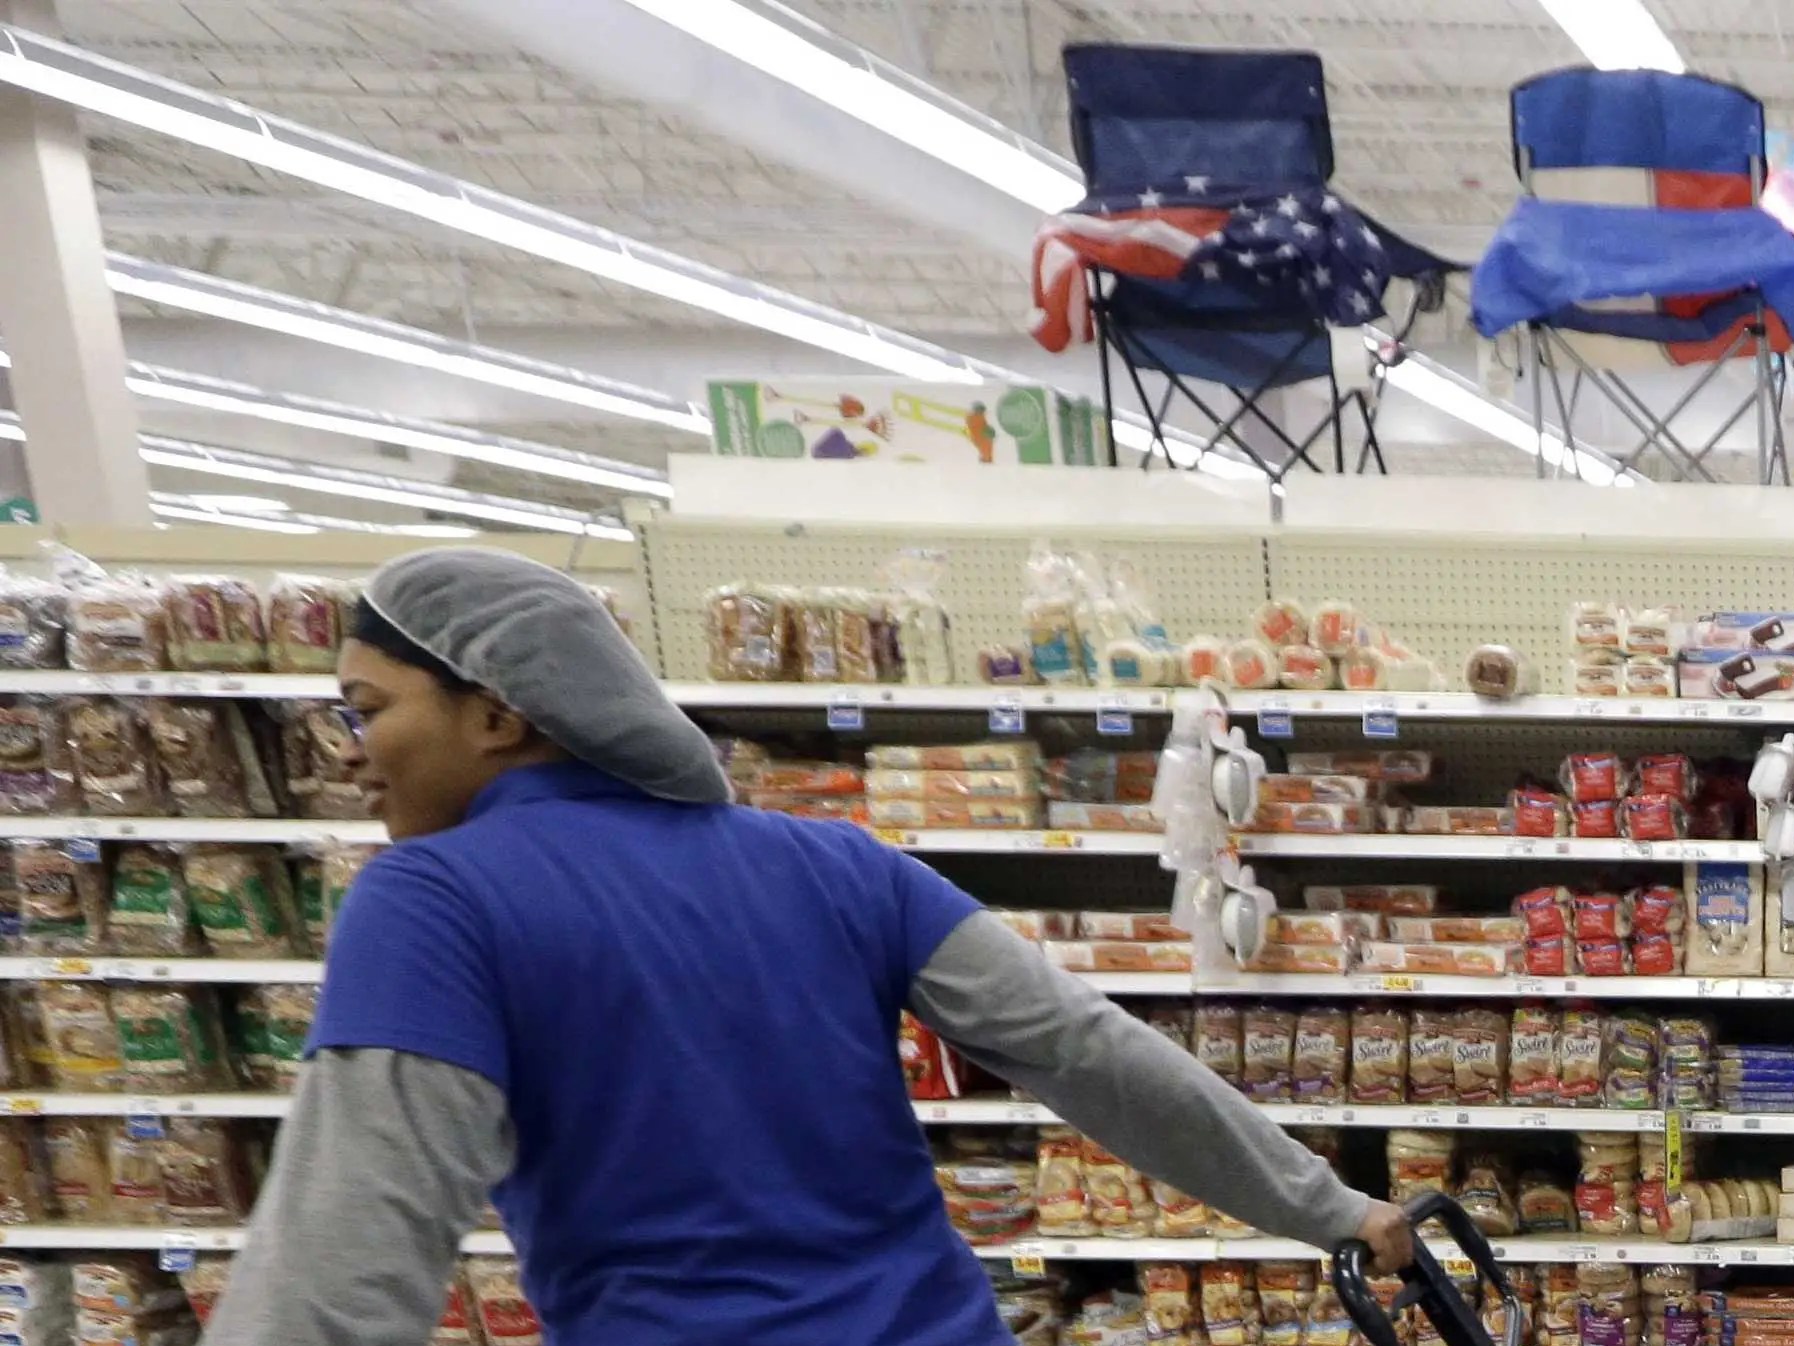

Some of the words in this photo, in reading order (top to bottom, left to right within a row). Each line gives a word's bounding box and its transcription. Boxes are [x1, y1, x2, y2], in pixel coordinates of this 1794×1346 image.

[1249, 1038, 1285, 1054] Swirl
[1357, 1042, 1393, 1061] Swirl
[1412, 1040, 1451, 1058] Swirl
[1455, 1046, 1489, 1064] Swirl
[1514, 1037, 1549, 1055] Swirl
[1563, 1038, 1596, 1058] Swirl
